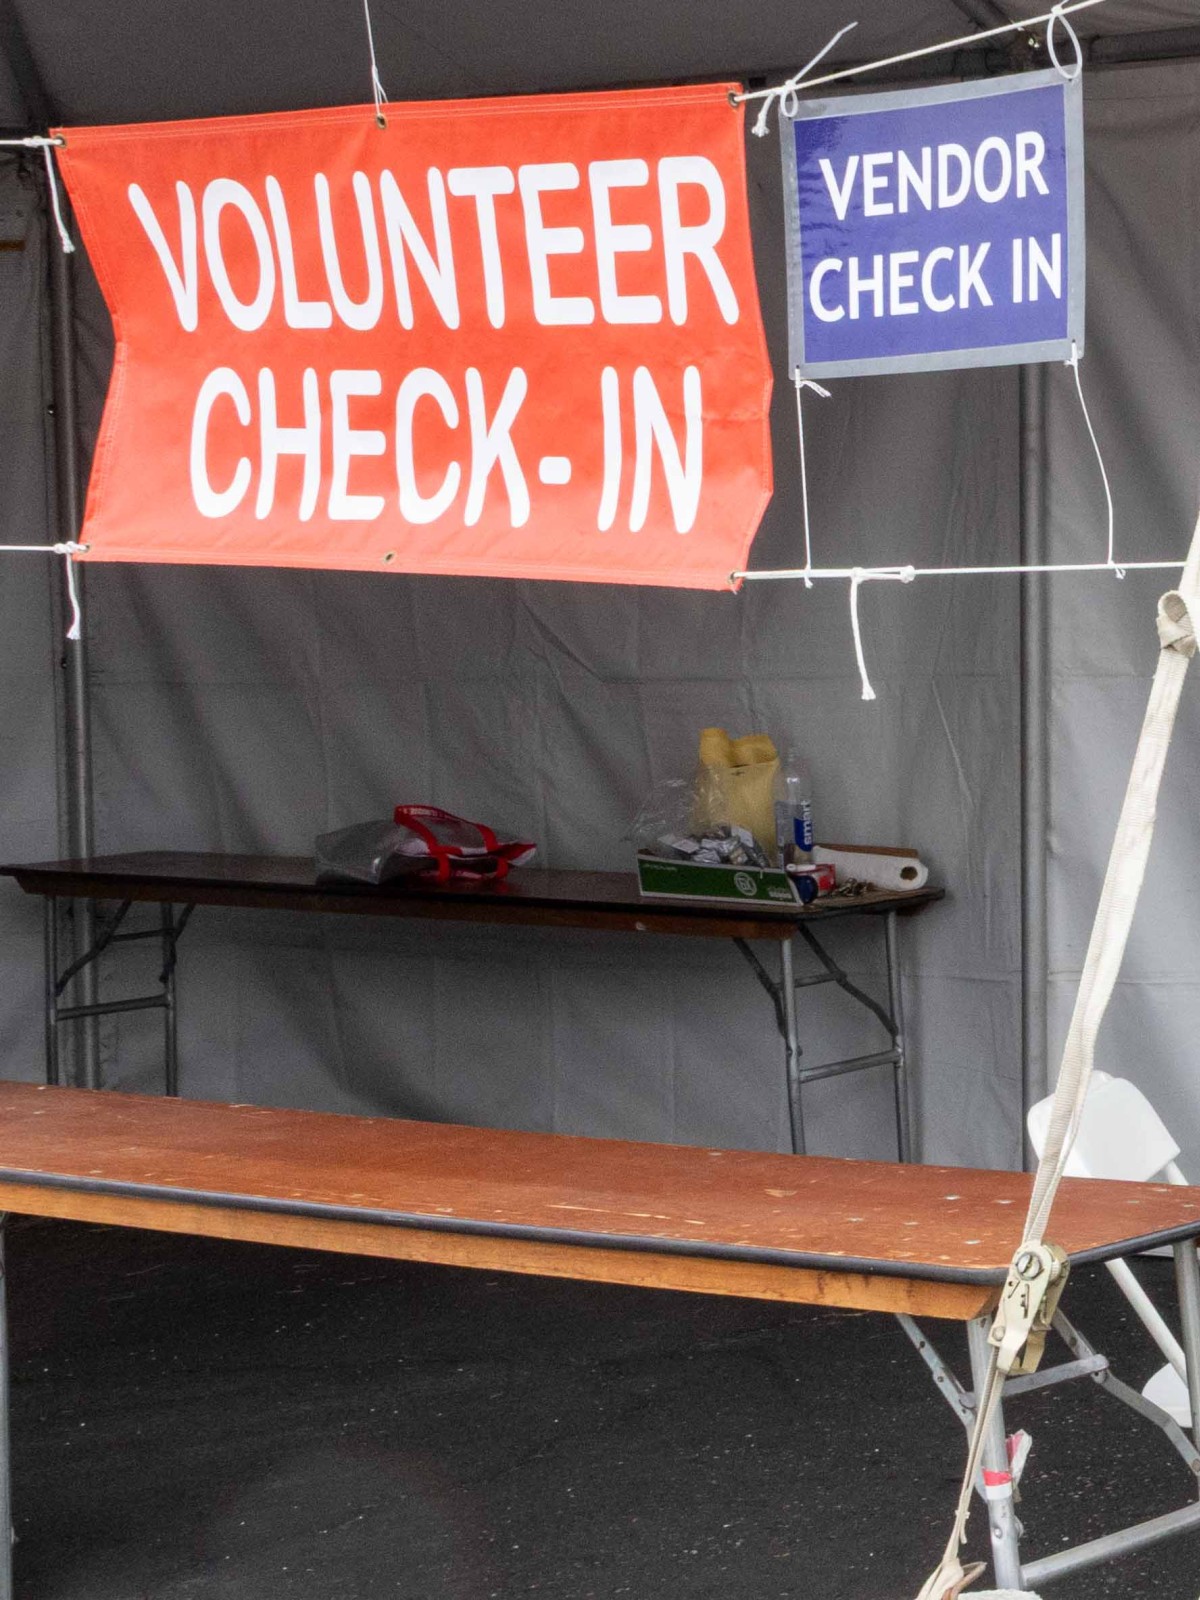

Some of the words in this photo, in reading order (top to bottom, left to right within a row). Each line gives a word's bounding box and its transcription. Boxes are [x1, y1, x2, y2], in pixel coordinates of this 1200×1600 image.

[818, 130, 1050, 221] VENDOR
[127, 154, 740, 332] VOLUNTEER
[808, 241, 994, 323] CHECK
[1011, 232, 1062, 304] IN
[800, 799, 813, 846] smart
